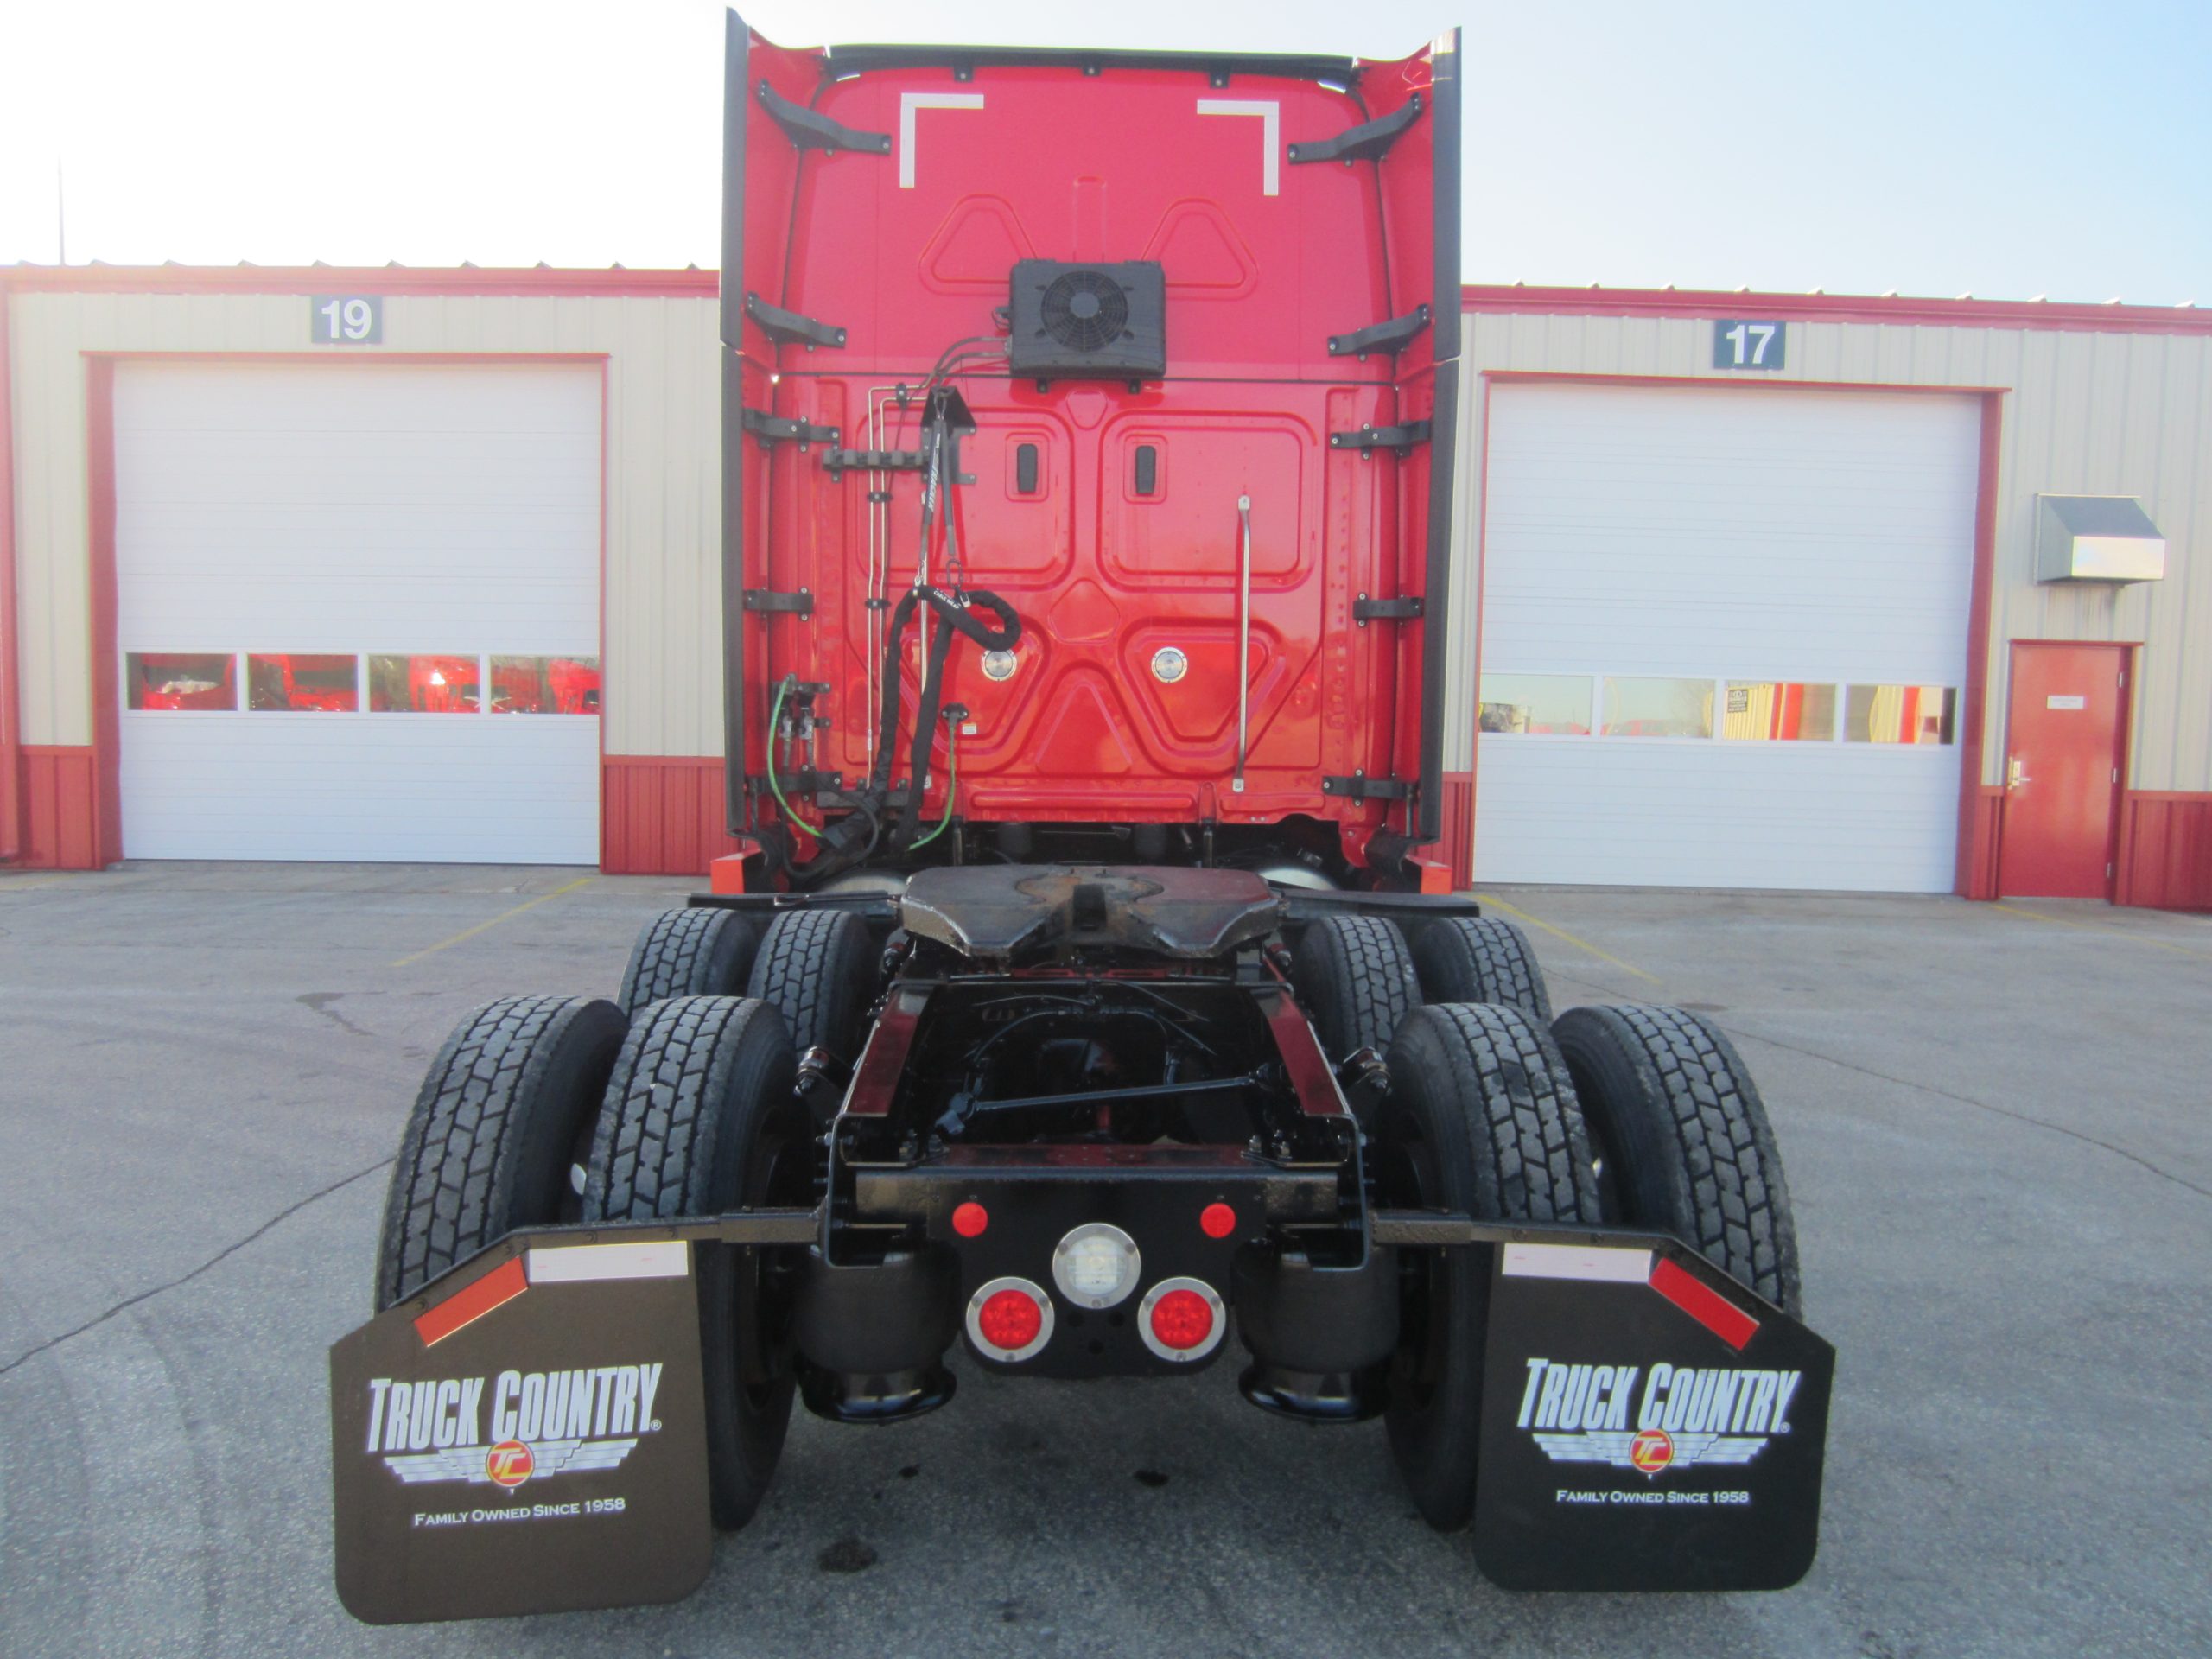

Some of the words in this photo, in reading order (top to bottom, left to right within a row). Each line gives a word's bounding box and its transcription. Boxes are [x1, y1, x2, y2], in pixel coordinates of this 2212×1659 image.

[321, 299, 372, 339] 19
[1726, 325, 1775, 364] 17
[1516, 1357, 1639, 1430] TRUCK
[367, 1377, 485, 1452] TRUCK
[414, 1512, 468, 1527] FAMILY
[472, 1507, 531, 1522] OWNED
[533, 1503, 580, 1517] SINCE
[584, 1497, 626, 1512] 1958
[1556, 1490, 1607, 1503] FAMILY
[1610, 1491, 1664, 1503] OWNED
[1666, 1491, 1709, 1503] SINCE
[1713, 1491, 1750, 1503] 1958
